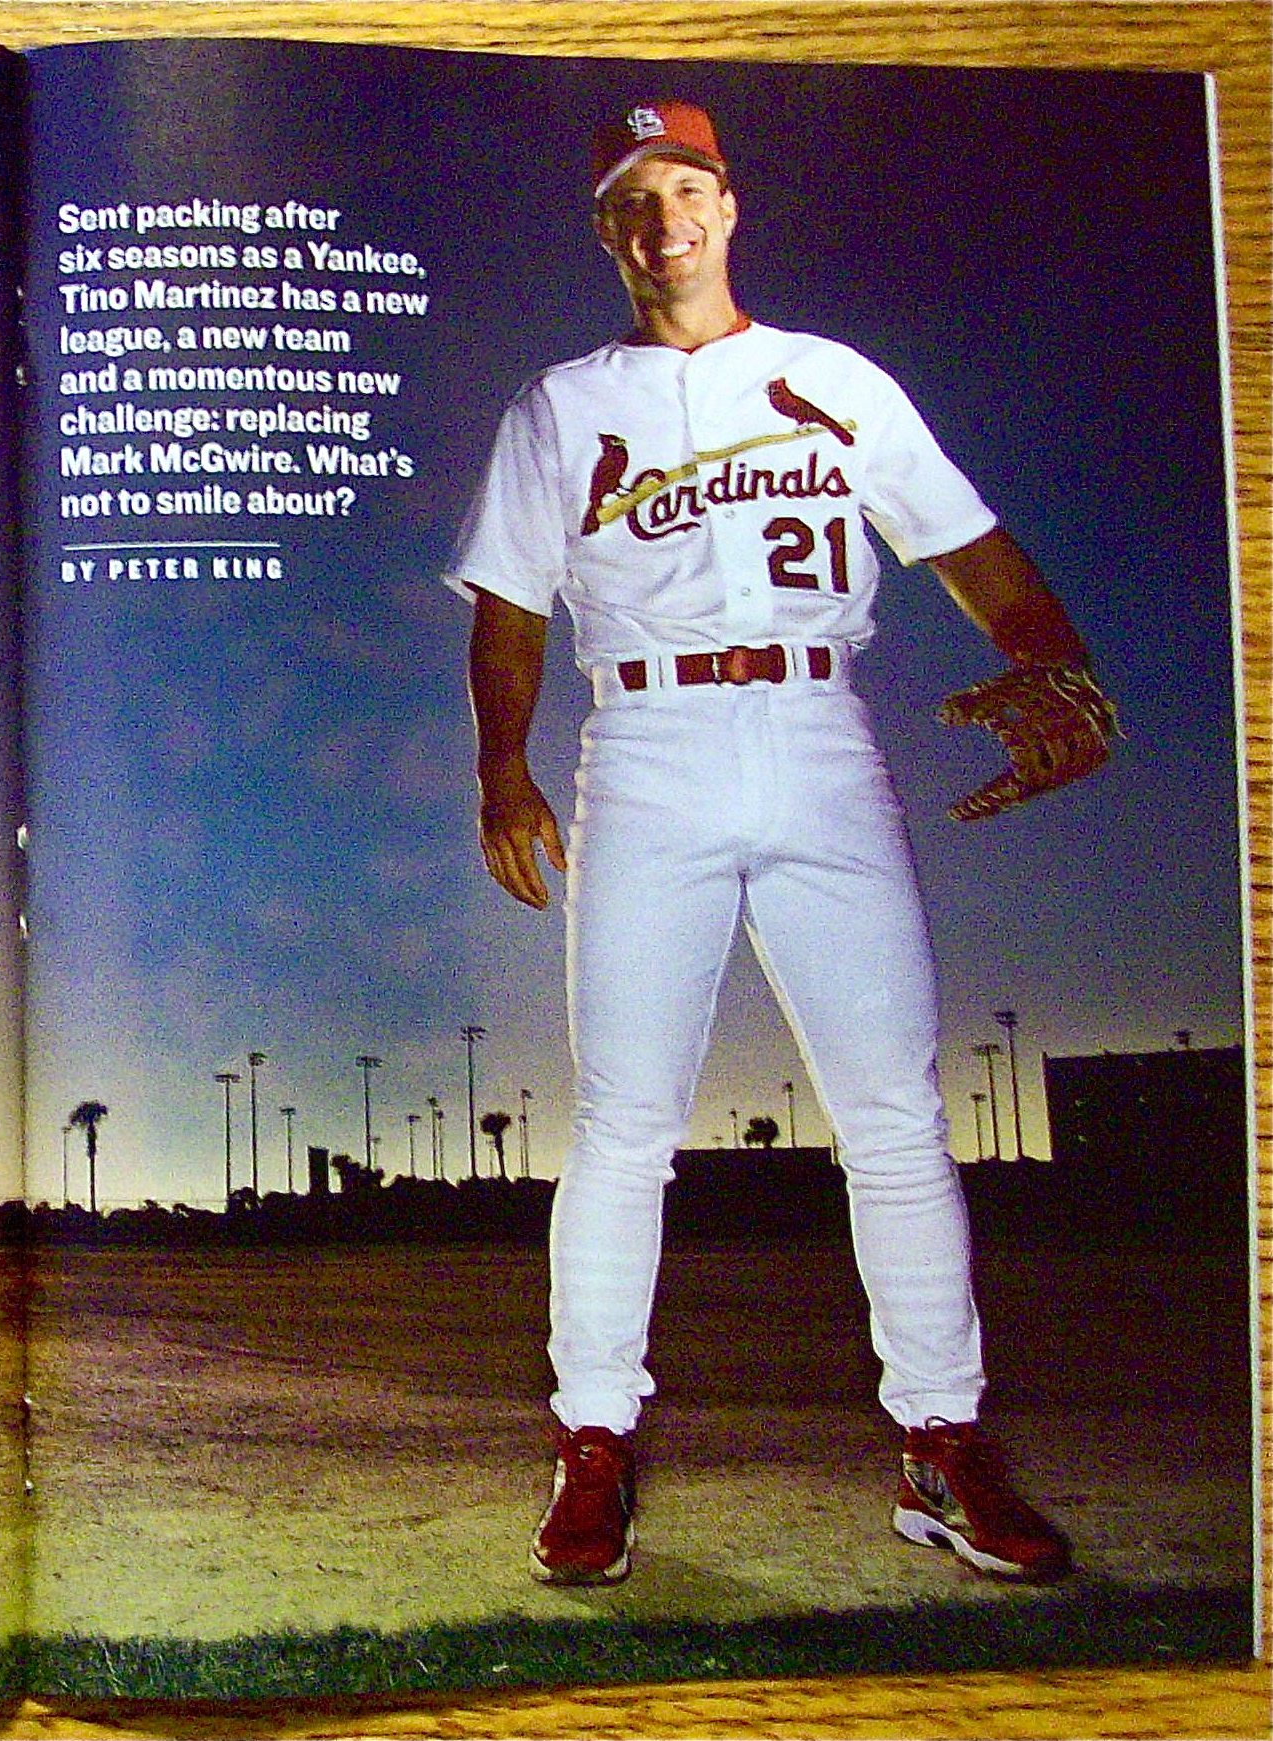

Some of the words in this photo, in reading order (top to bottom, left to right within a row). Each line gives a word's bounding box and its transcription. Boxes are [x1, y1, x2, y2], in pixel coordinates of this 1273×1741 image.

[59, 202, 130, 233] Sent
[137, 199, 261, 234] packing
[265, 202, 341, 232] after
[59, 245, 102, 273] six
[109, 245, 236, 269] seasons
[243, 245, 278, 268] as
[285, 247, 303, 269] a
[308, 241, 426, 279] Yankee,
[59, 283, 126, 314] Tino
[134, 280, 276, 311] Martinez
[283, 281, 335, 312] has
[343, 289, 361, 312] a
[366, 291, 428, 315] new
[60, 327, 170, 357] league,
[177, 326, 195, 349] a
[202, 326, 268, 349] new
[273, 323, 350, 353] team
[60, 363, 117, 394] and
[124, 367, 143, 391] a
[150, 367, 332, 393] momentous
[338, 371, 401, 395] new
[60, 403, 219, 437] challenge:
[226, 403, 370, 440] replacing
[61, 445, 143, 476] Mark
[150, 442, 300, 474] McGwire.
[307, 444, 414, 477] What's
[61, 487, 112, 517] not
[120, 487, 149, 514] to
[157, 485, 240, 513] smile
[248, 485, 355, 516] about?
[626, 451, 851, 540] Cardinals
[61, 560, 95, 582] BY
[110, 557, 198, 580] PETER
[213, 557, 282, 579] KING
[762, 518, 849, 593] 21
